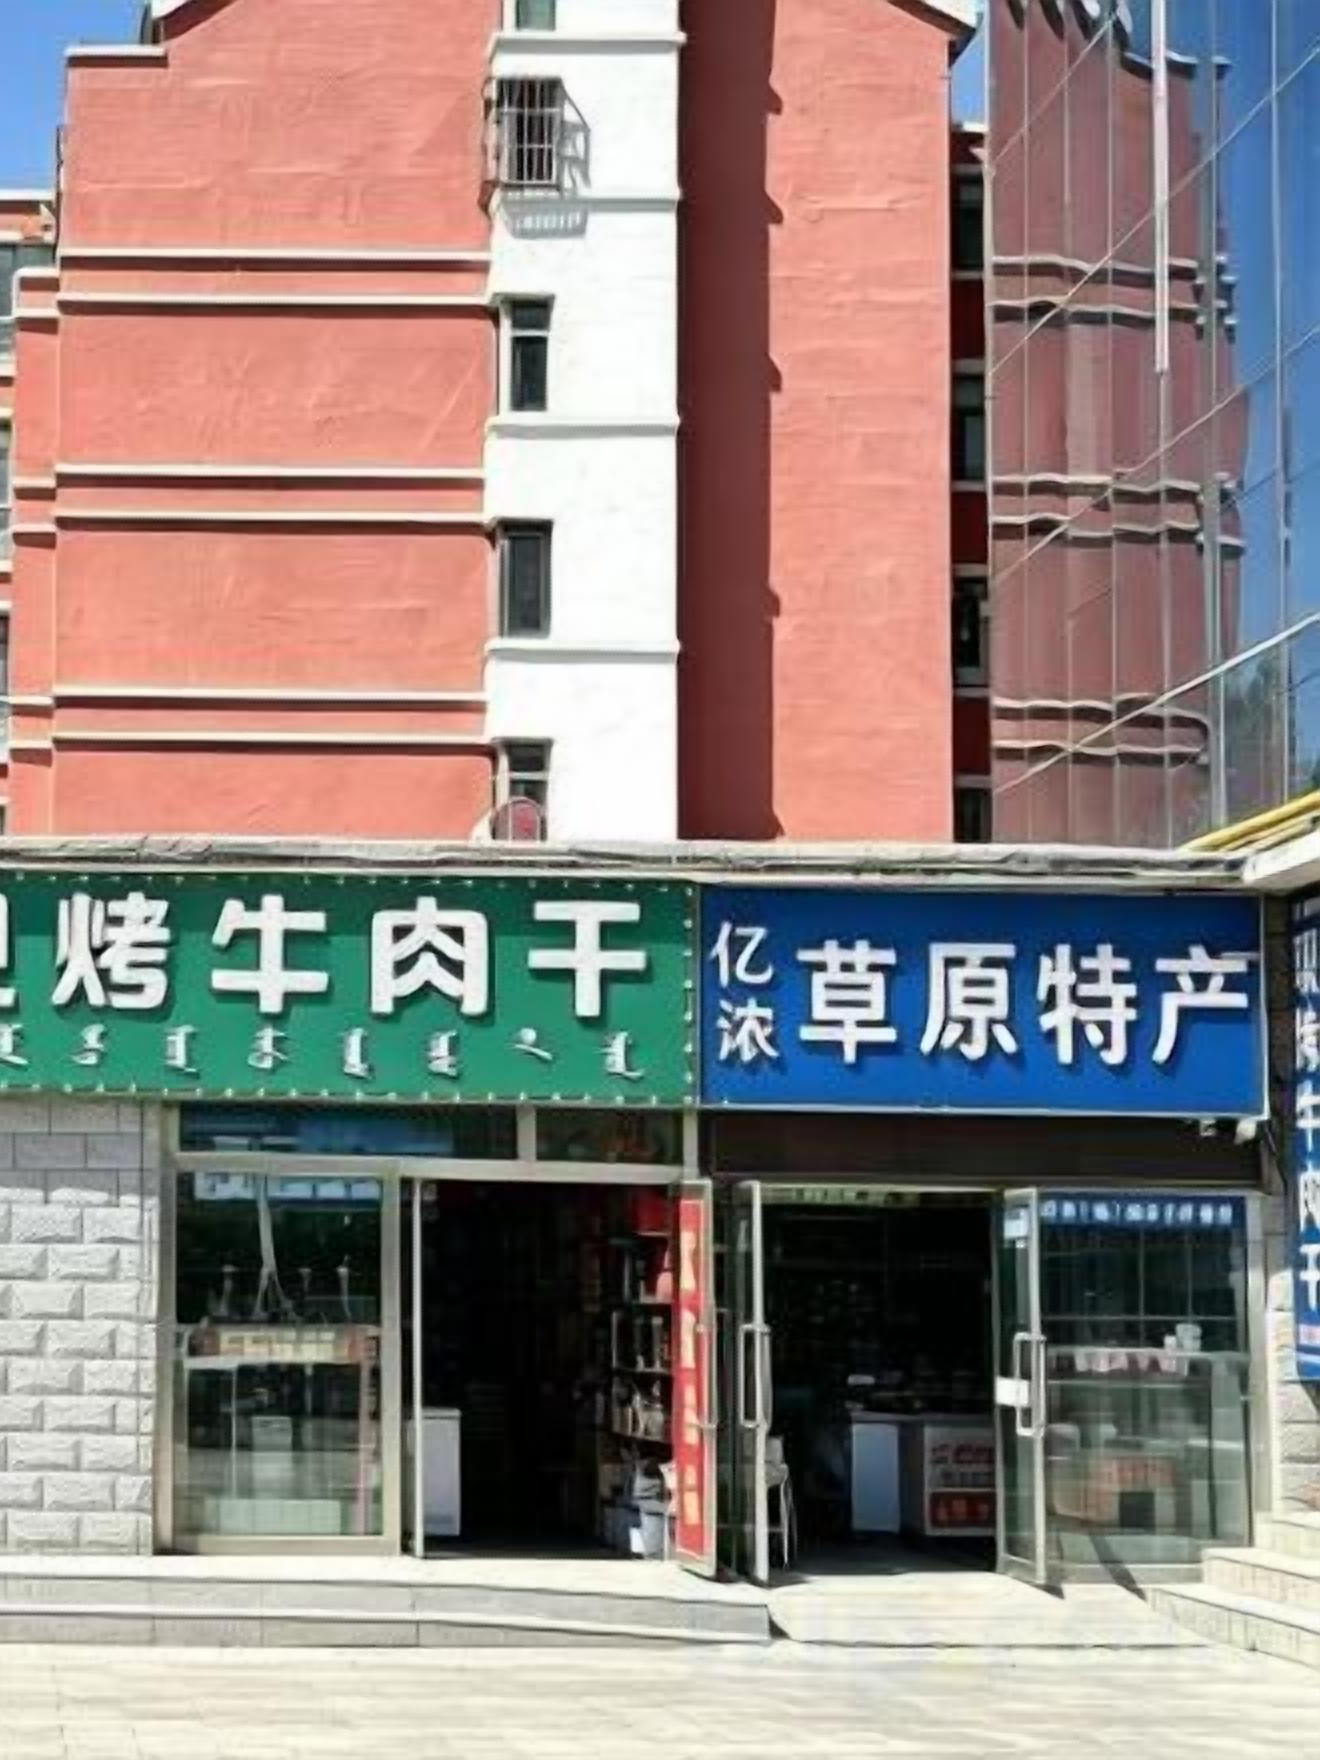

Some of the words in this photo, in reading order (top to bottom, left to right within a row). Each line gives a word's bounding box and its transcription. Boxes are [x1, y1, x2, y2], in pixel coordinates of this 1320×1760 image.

[710, 920, 780, 1063] 亿浓
[796, 939, 1250, 1065] 草原特产
